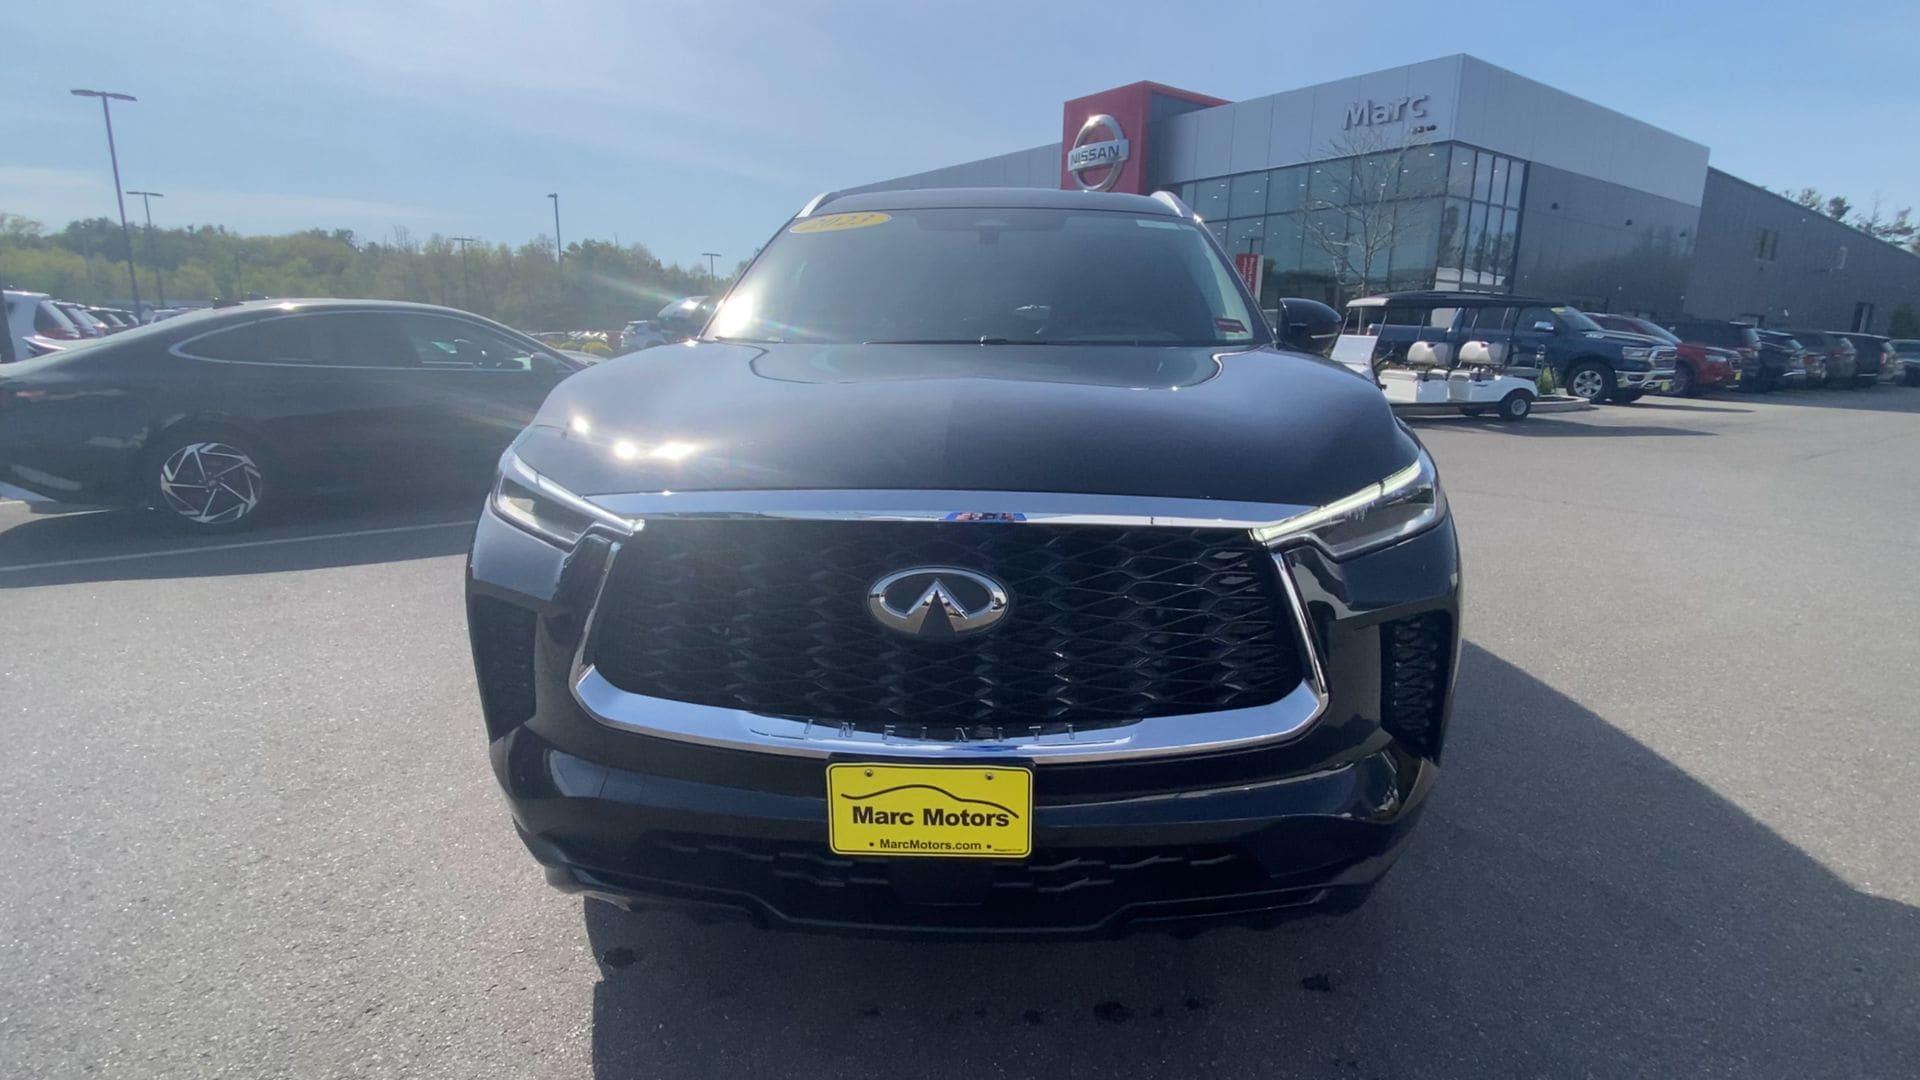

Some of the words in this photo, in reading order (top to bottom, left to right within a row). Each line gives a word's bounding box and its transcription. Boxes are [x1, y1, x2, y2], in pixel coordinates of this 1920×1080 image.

[1344, 94, 1431, 131] Marc
[1071, 144, 1120, 164] NISSAN
[852, 806, 914, 825] Marc
[923, 808, 1010, 827] Motors
[879, 838, 982, 851] MarcMotors.com
